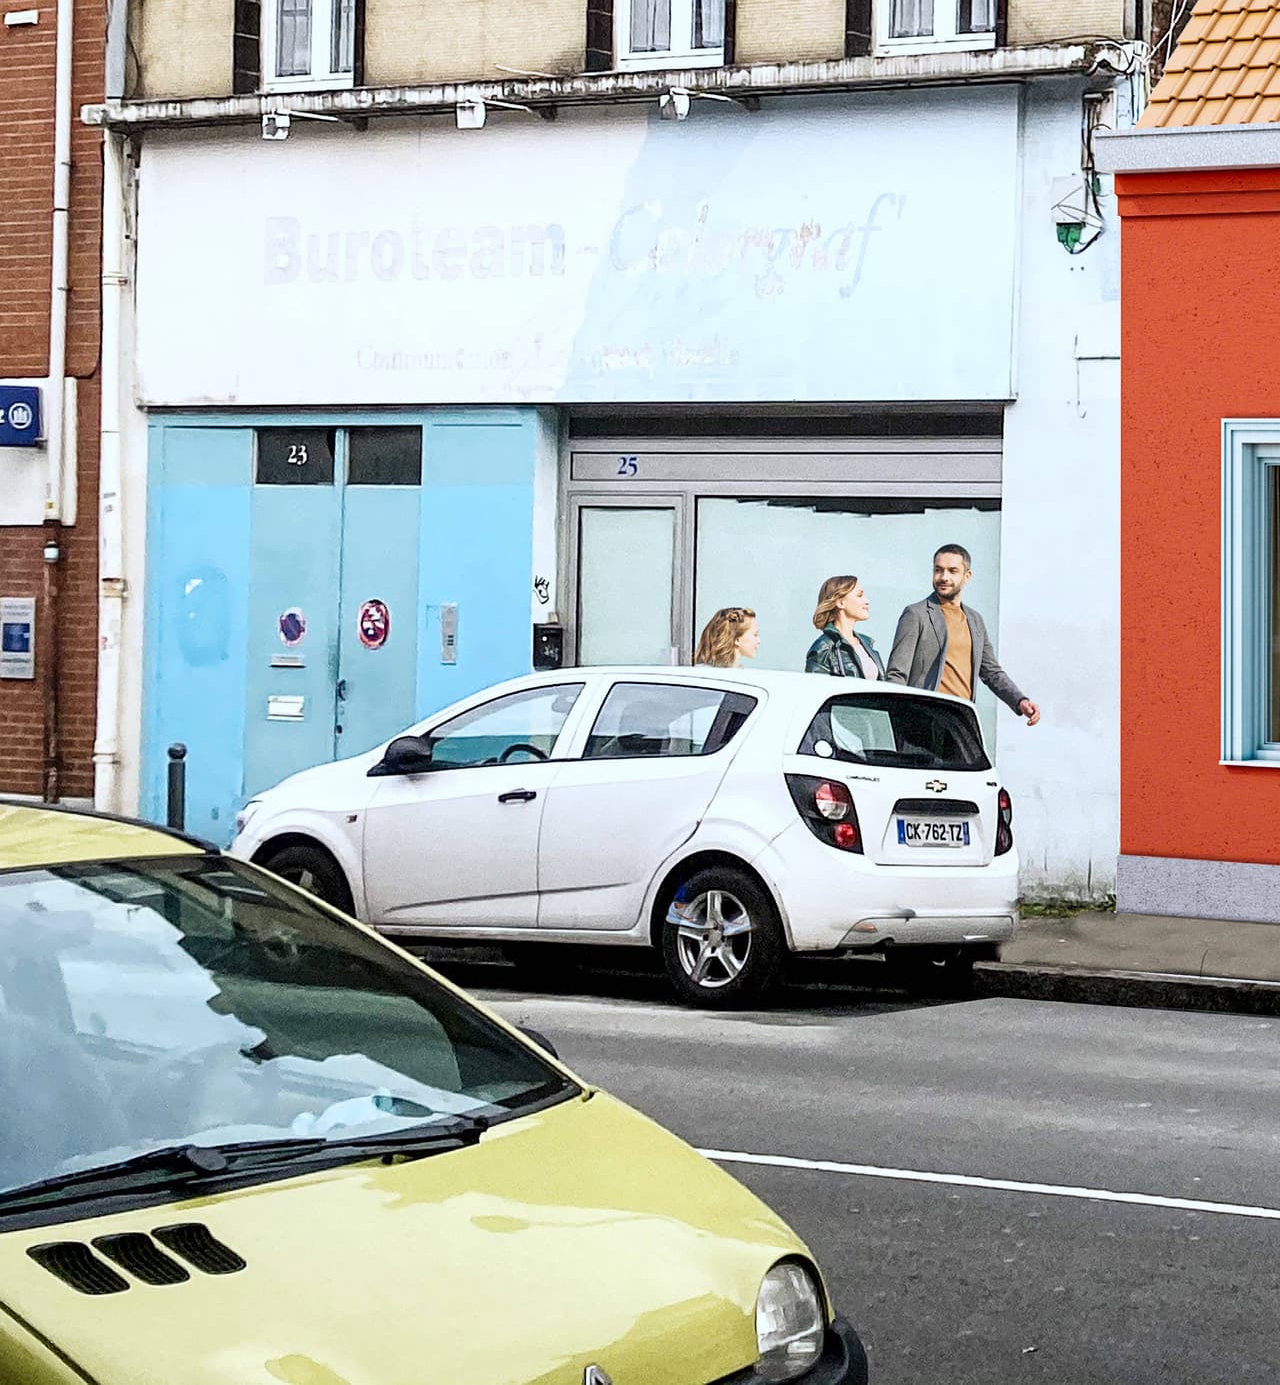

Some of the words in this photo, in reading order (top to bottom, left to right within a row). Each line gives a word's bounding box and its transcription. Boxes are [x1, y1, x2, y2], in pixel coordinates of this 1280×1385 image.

[264, 211, 567, 285] Buroteam
[287, 444, 308, 467] 23
[616, 456, 639, 476] 25
[905, 822, 963, 843] CK-762-TZ
